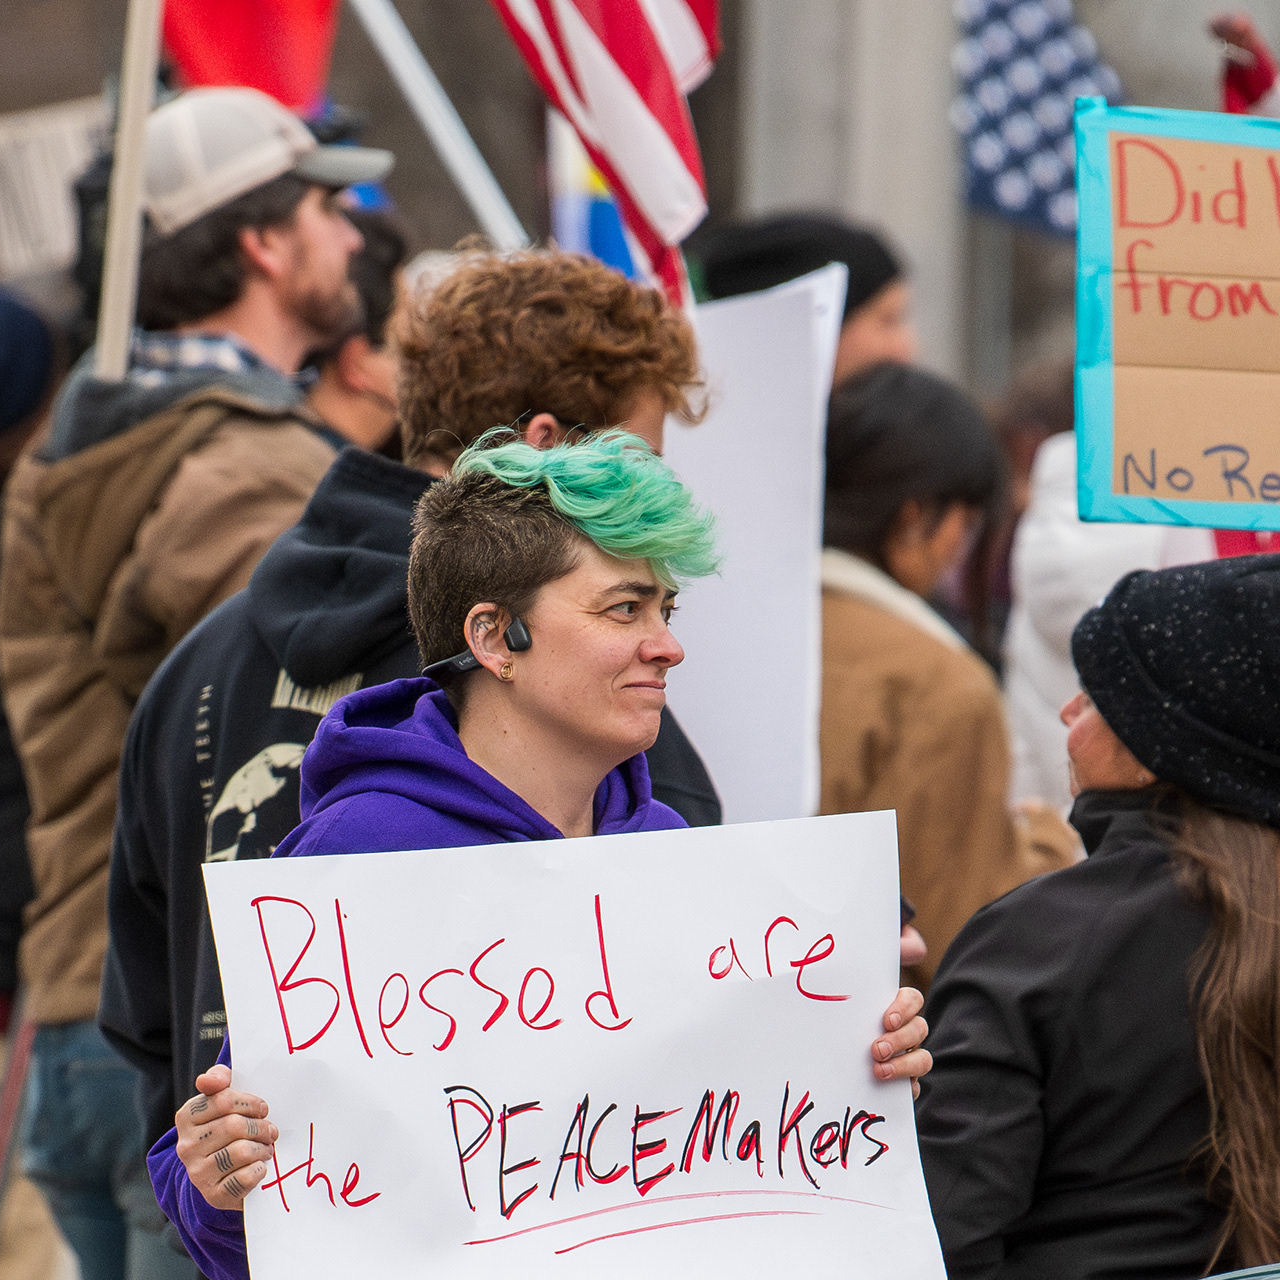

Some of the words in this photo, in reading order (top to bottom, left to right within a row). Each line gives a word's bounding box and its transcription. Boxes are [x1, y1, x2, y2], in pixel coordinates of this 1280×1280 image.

[1116, 138, 1247, 228] Did
[1122, 448, 1195, 495] No
[250, 893, 634, 1059] Blessed
[707, 914, 851, 1003] are
[261, 1122, 382, 1213] the
